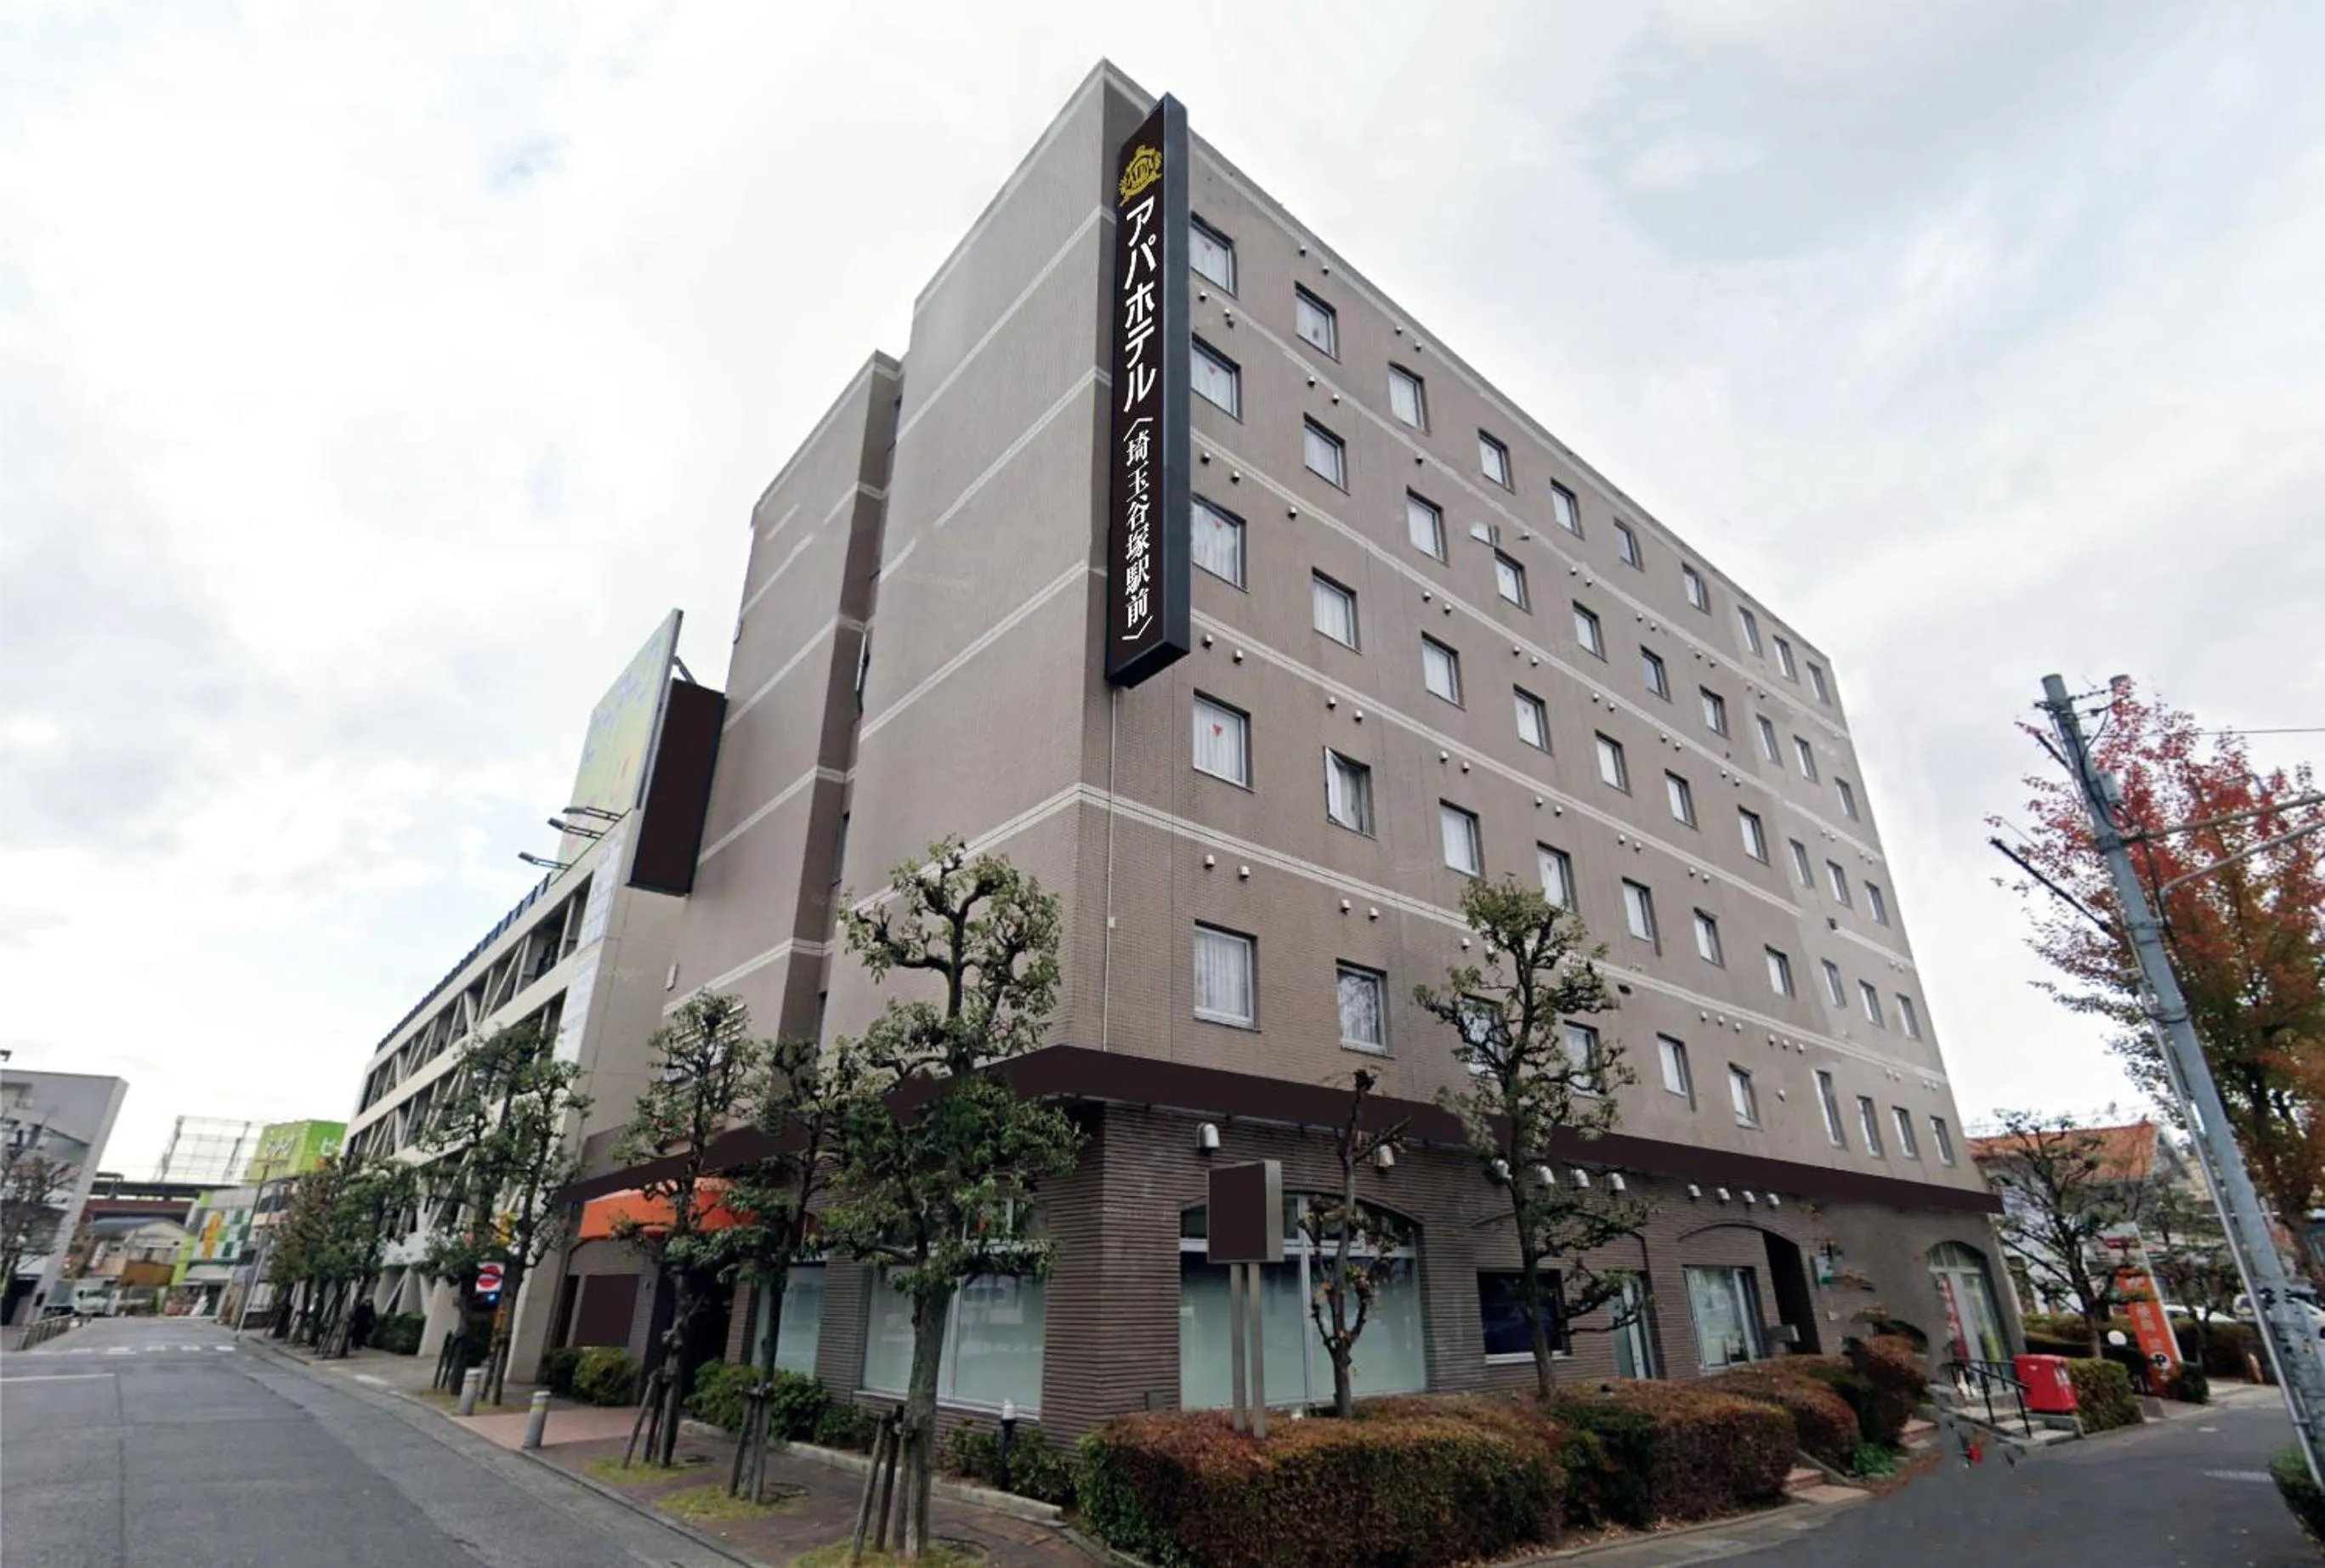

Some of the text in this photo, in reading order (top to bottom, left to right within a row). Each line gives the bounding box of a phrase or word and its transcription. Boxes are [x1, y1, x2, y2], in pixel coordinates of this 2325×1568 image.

[1124, 195, 1157, 413] アパホテル
